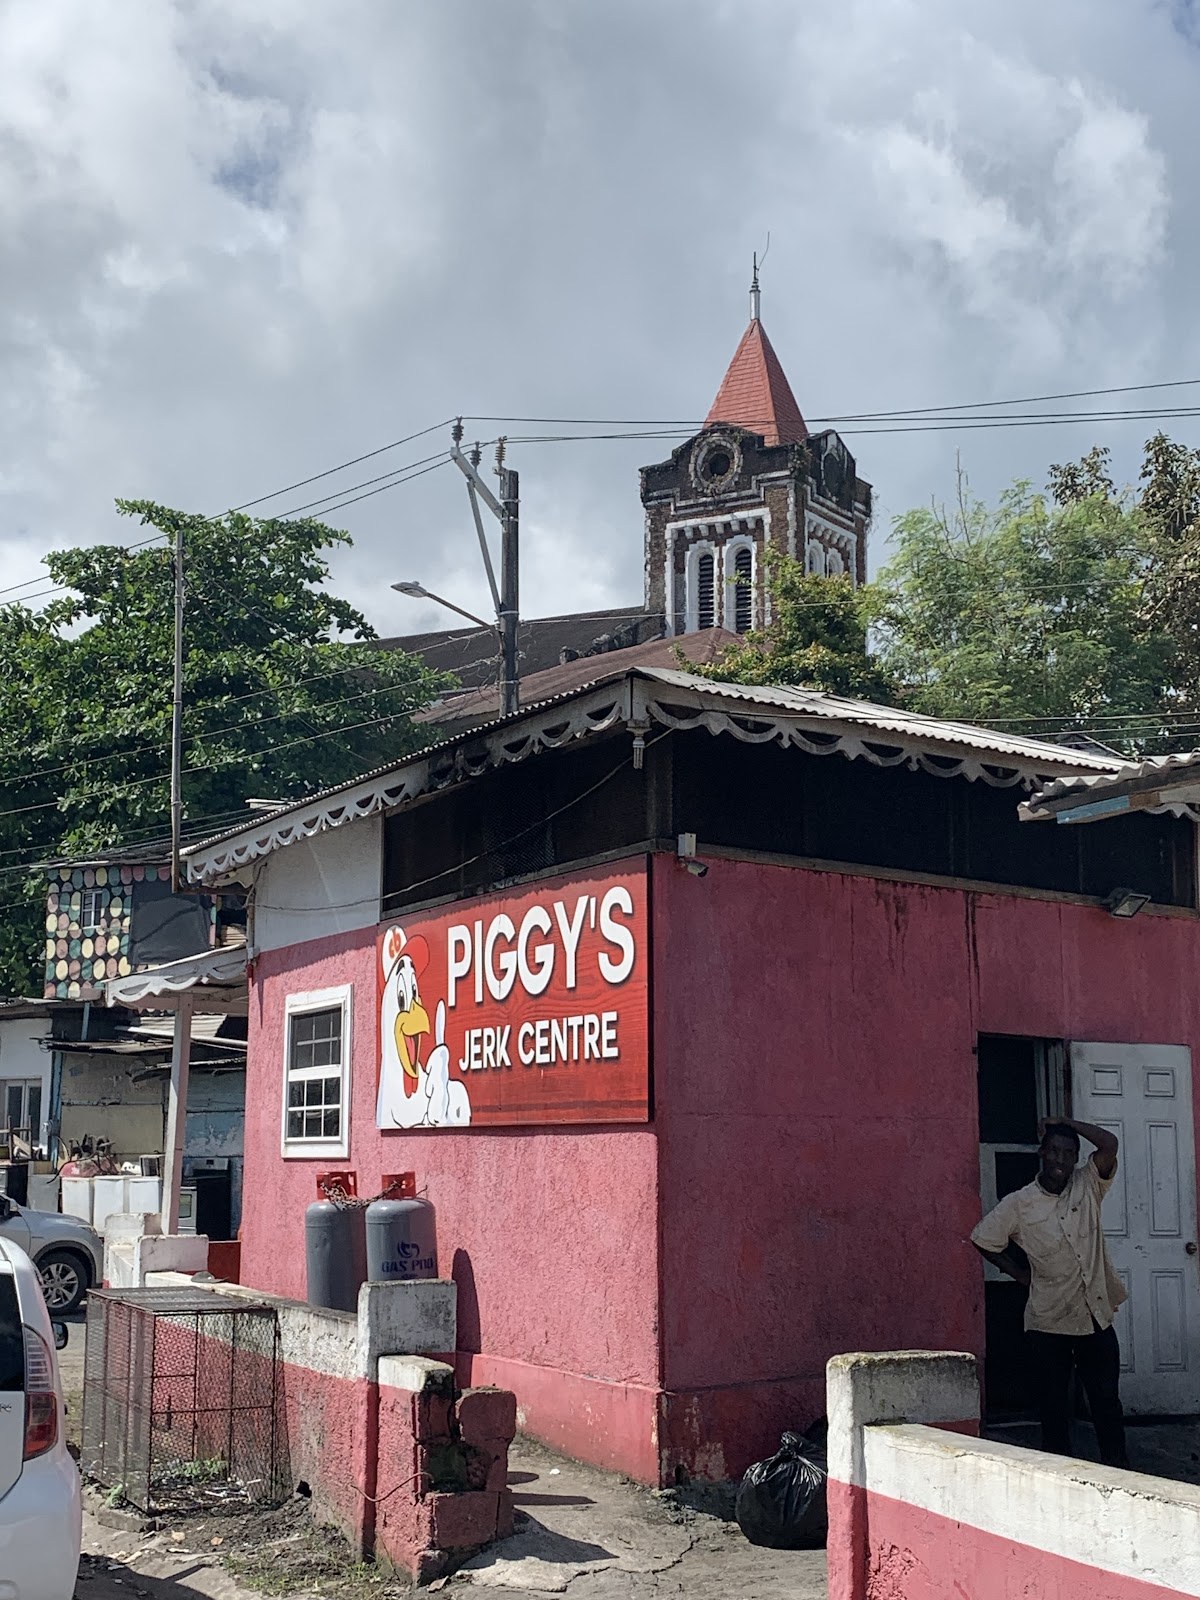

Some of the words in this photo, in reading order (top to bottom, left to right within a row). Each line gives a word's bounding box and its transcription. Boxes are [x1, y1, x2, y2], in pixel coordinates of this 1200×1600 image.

[447, 886, 635, 1006] PIGGY'S
[459, 1025, 511, 1071] JERK
[518, 1011, 618, 1065] CENTRE
[382, 1260, 407, 1273] GAS
